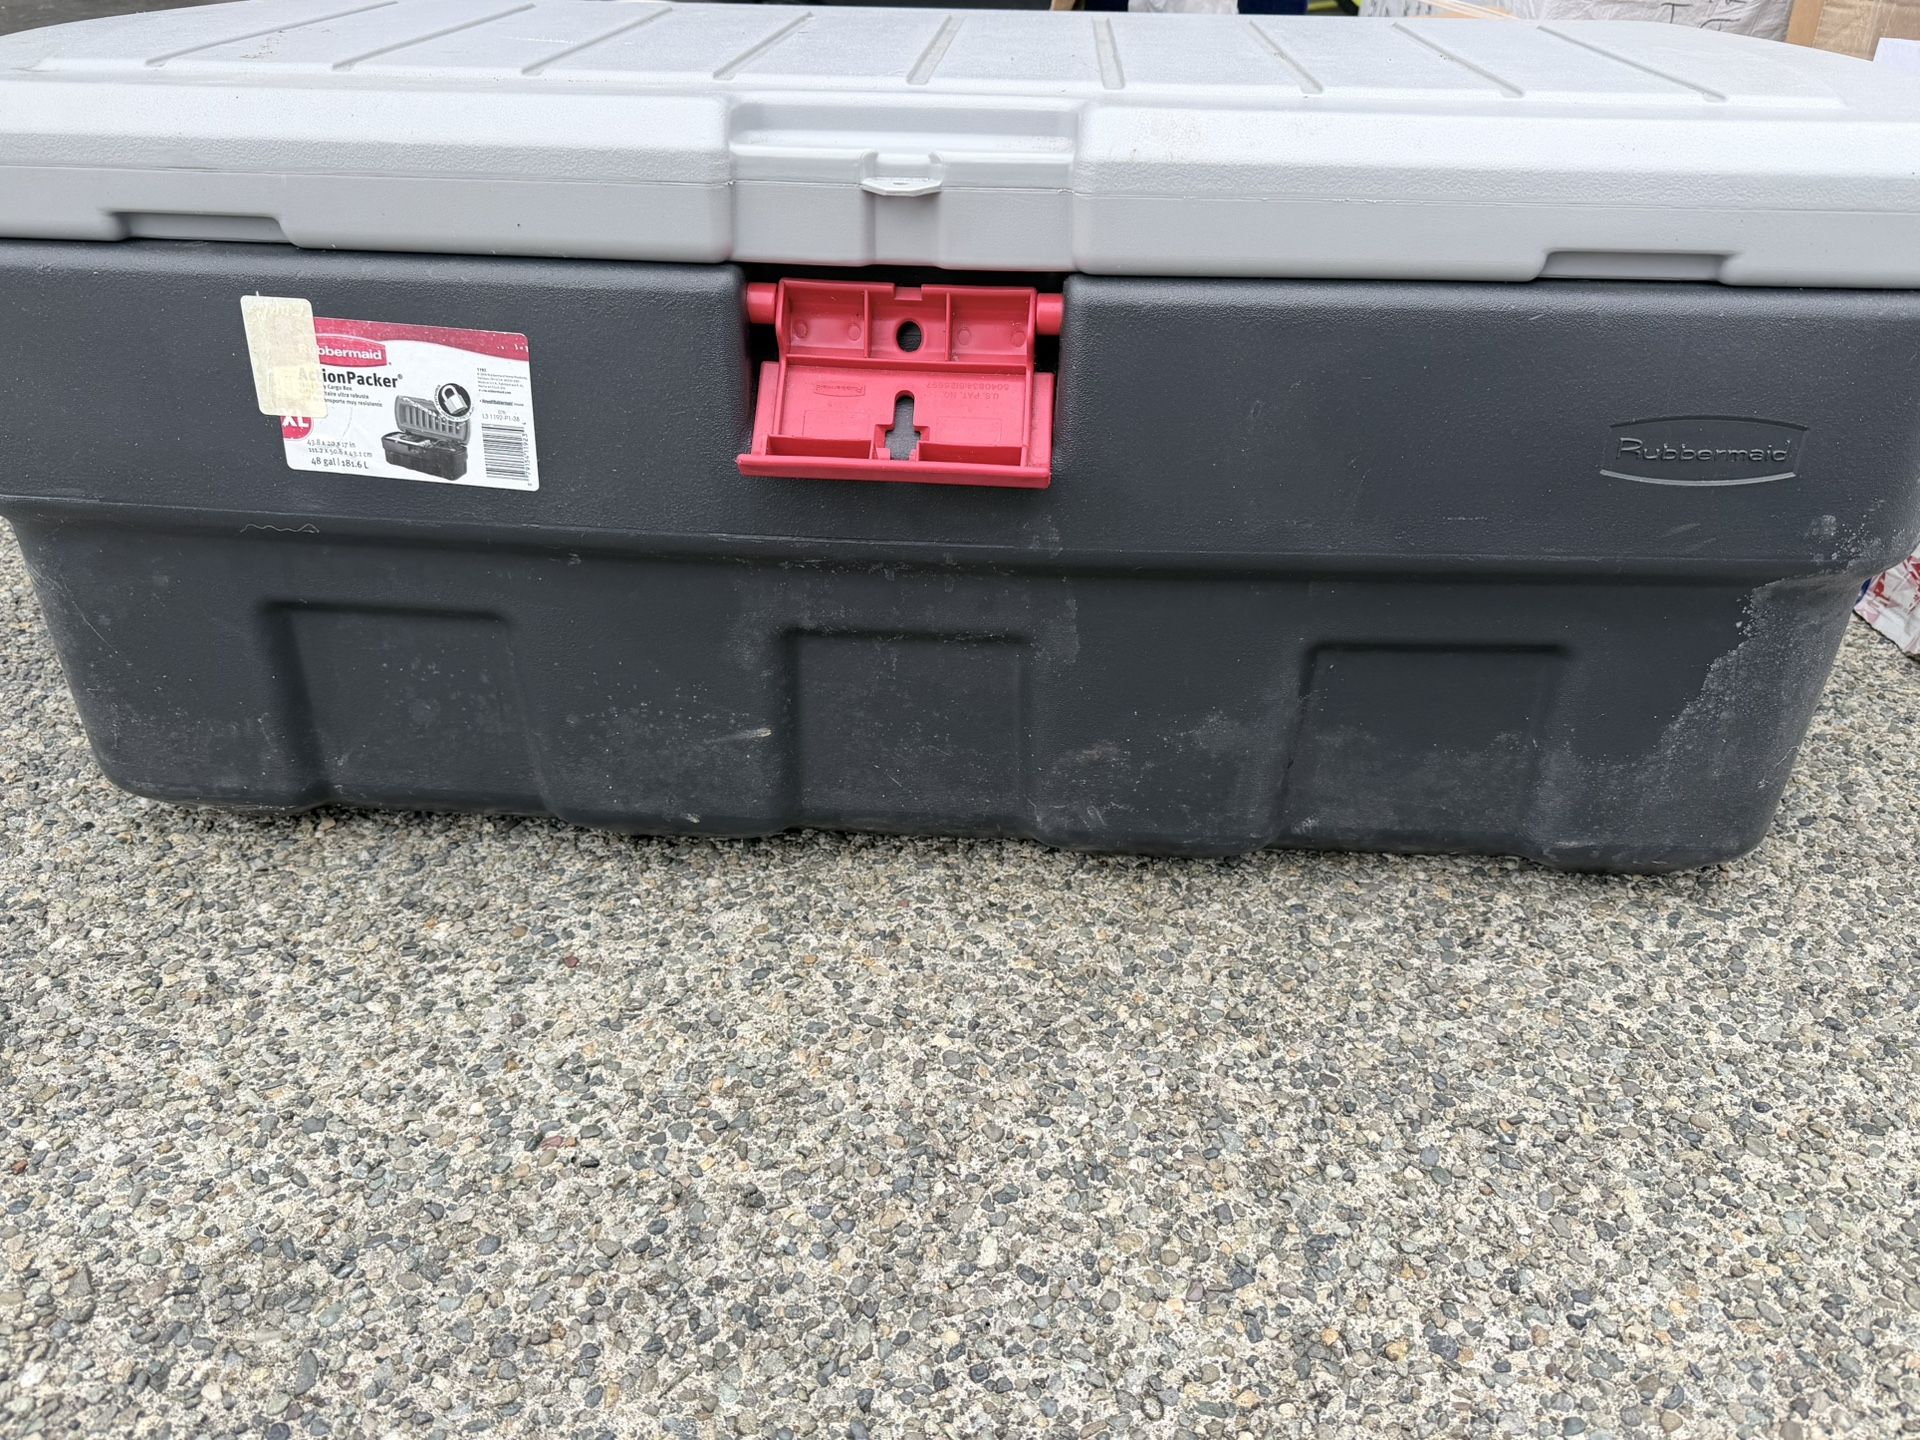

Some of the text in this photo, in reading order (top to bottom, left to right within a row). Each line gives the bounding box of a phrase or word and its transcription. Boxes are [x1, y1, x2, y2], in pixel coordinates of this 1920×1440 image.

[316, 345, 382, 360] bbermaid
[282, 412, 309, 428] XL
[1616, 437, 1791, 461] Rubbermaid
[311, 457, 321, 466] 48
[323, 457, 336, 467] gal
[341, 460, 362, 468] 181.6
